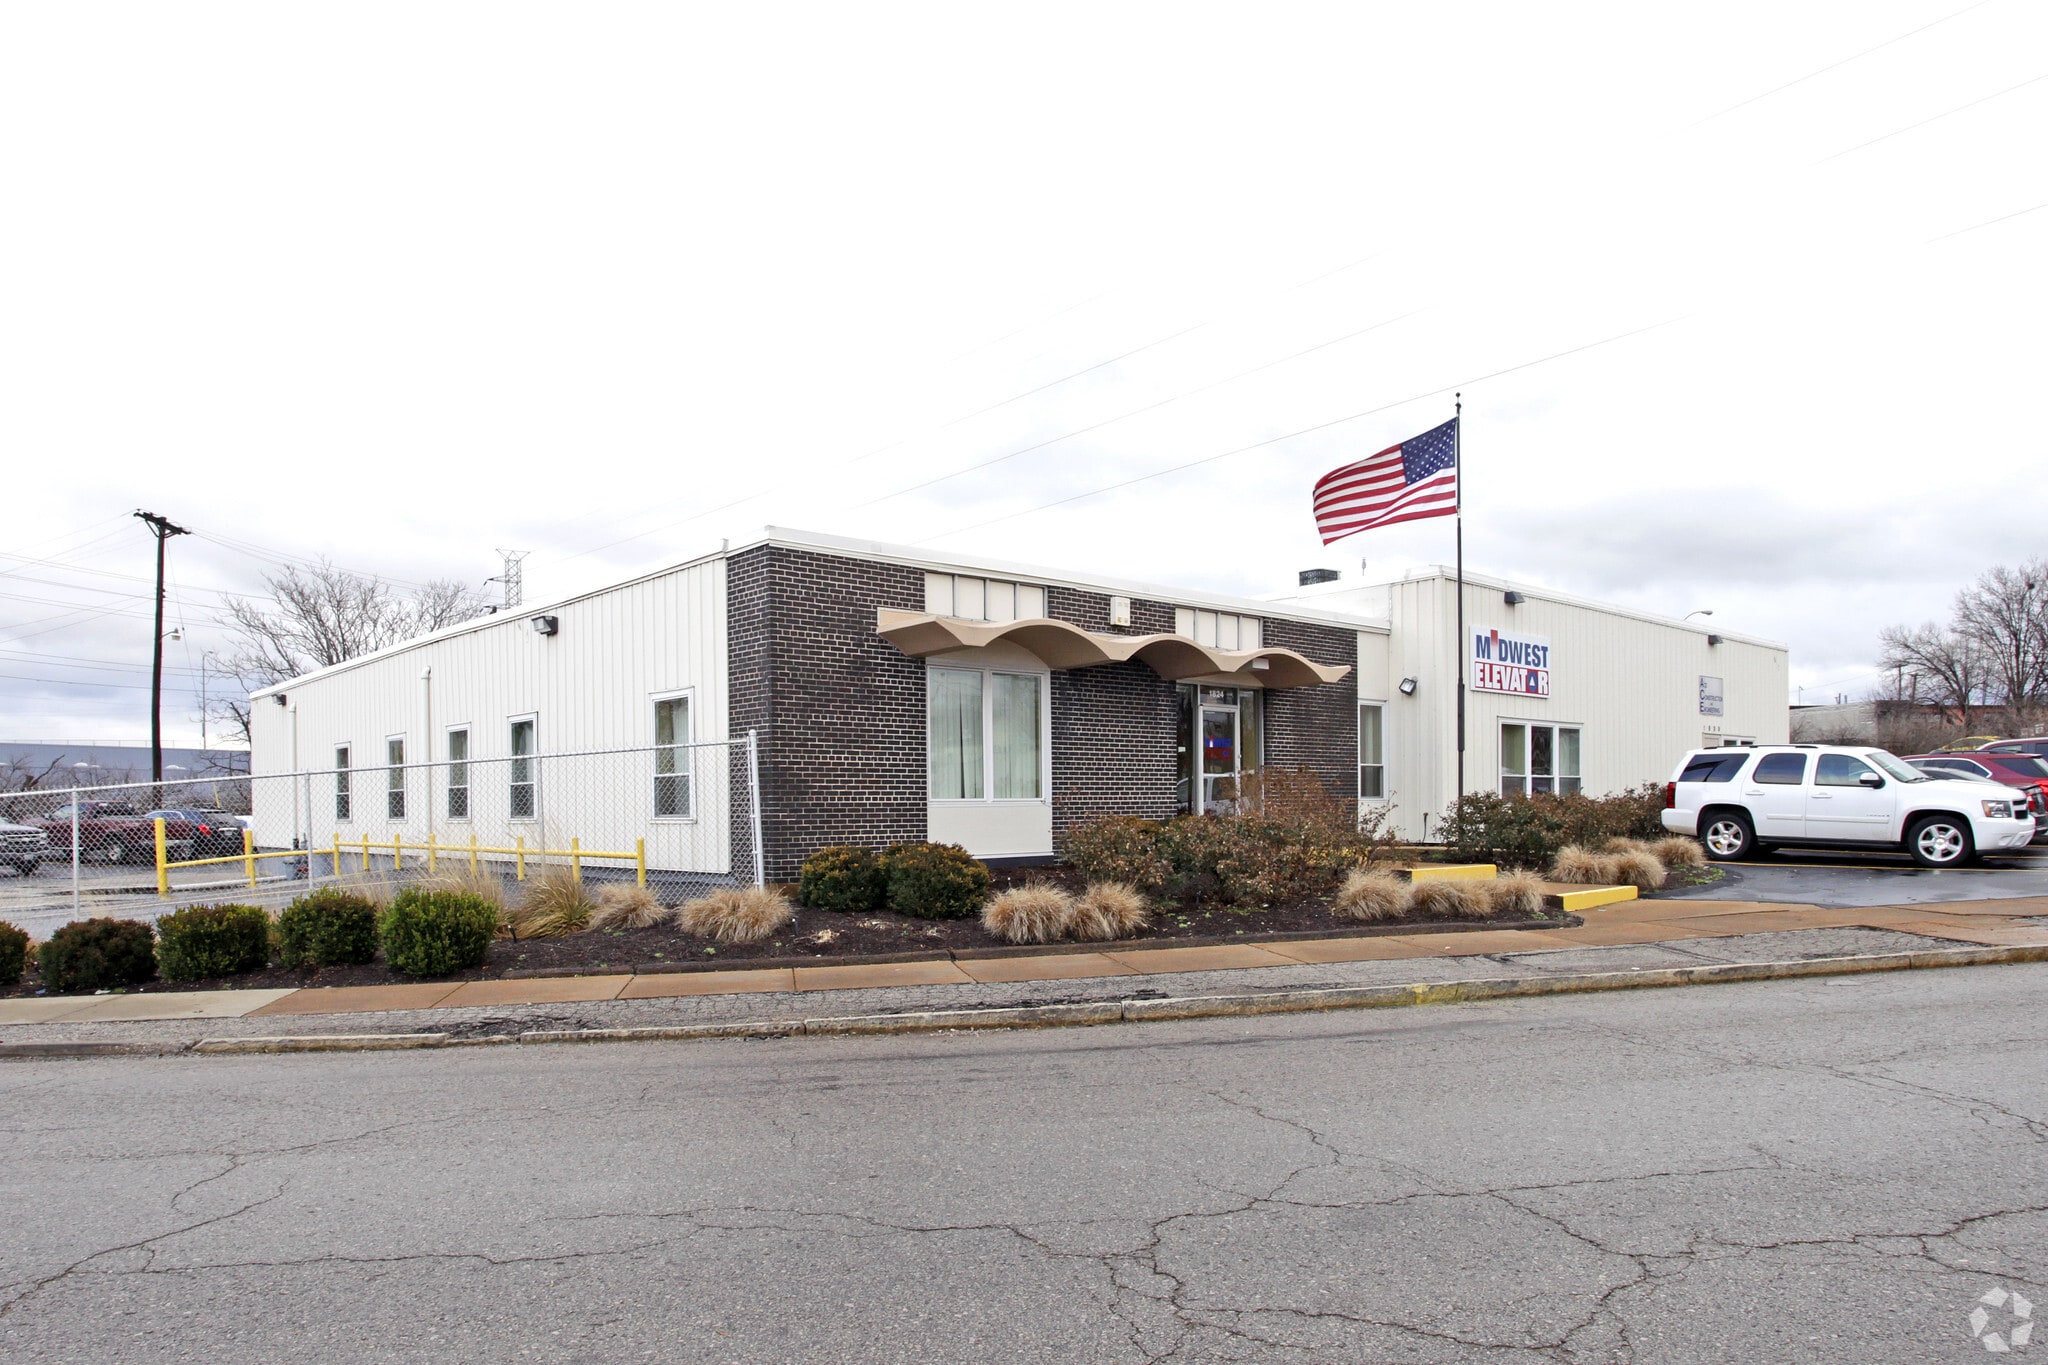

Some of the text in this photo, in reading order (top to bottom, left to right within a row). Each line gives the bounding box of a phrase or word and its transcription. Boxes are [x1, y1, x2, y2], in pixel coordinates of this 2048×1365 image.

[1476, 629, 1548, 668] MIDWEST
[1209, 689, 1224, 698] 1824
[1475, 662, 1549, 695] ELEVATOR
